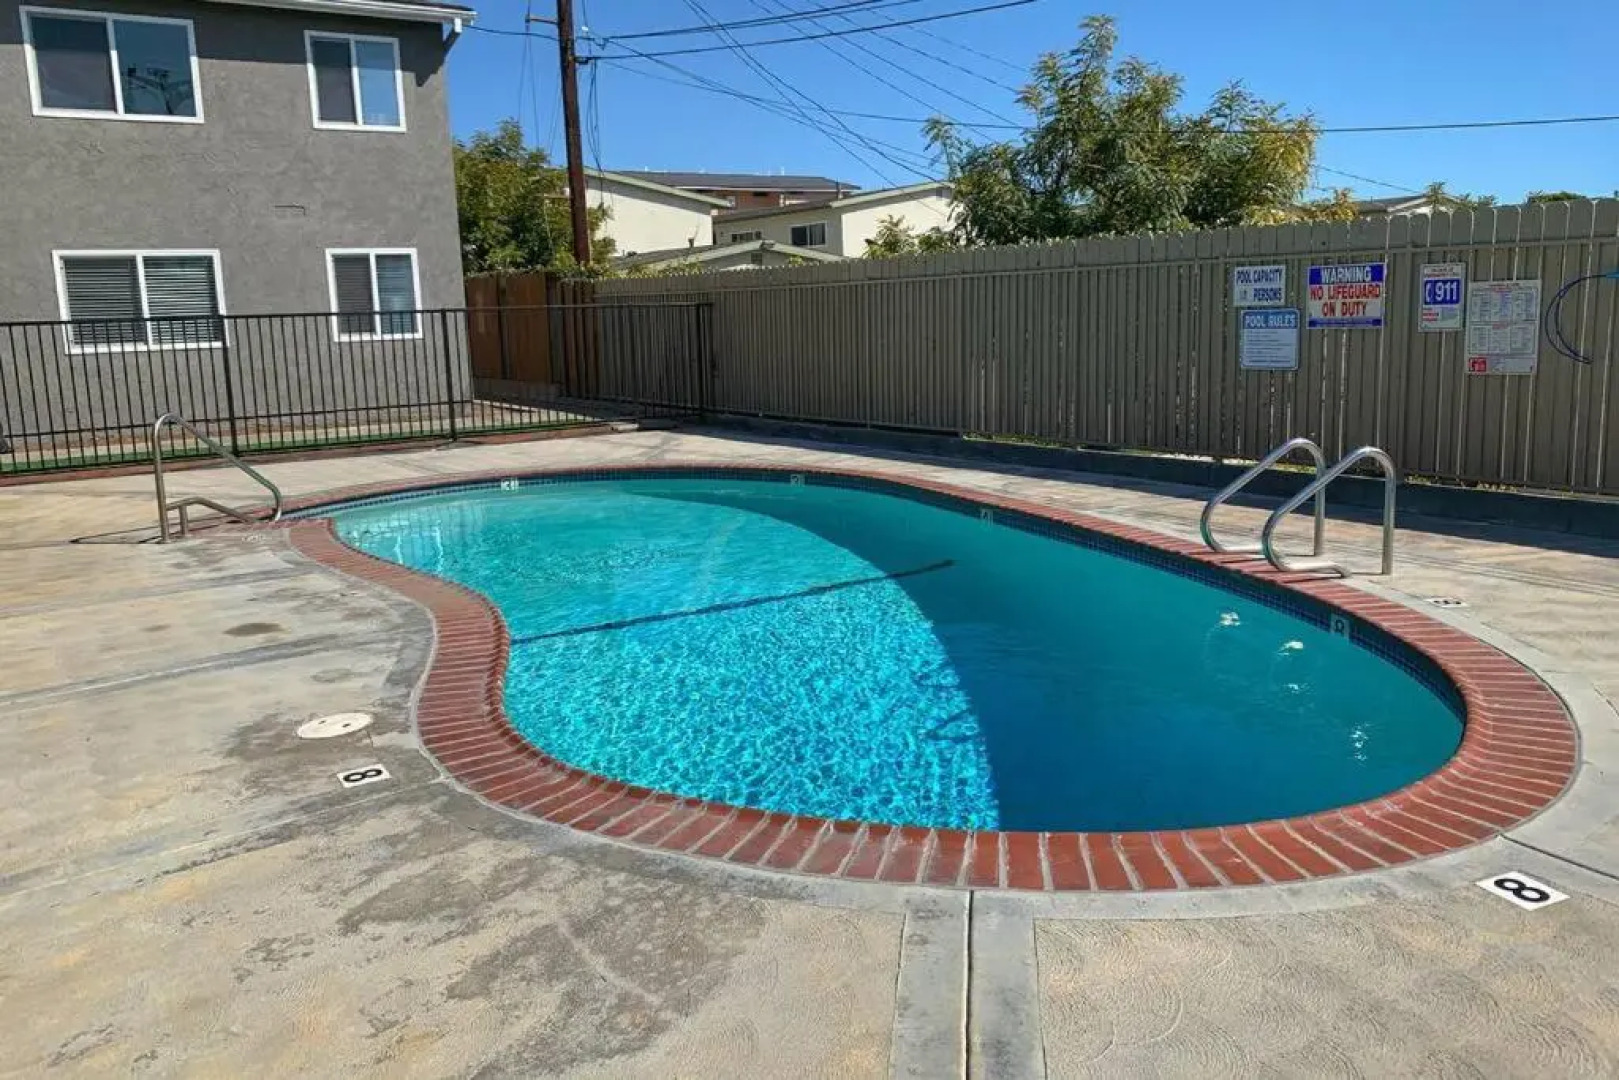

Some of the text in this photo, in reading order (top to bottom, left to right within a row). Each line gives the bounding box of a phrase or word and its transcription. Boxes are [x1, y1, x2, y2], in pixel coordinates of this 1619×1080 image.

[1237, 268, 1282, 284] POOL CAPACITY
[1321, 267, 1372, 283] WARNING
[1253, 288, 1282, 302] PERSONS
[1310, 284, 1381, 300] NO LIFEGUARD
[1435, 281, 1458, 303] 911
[1322, 301, 1367, 317] ON DUTY
[1245, 314, 1295, 327] POOL RULES
[342, 768, 383, 783] 8
[1493, 878, 1550, 902] 8
